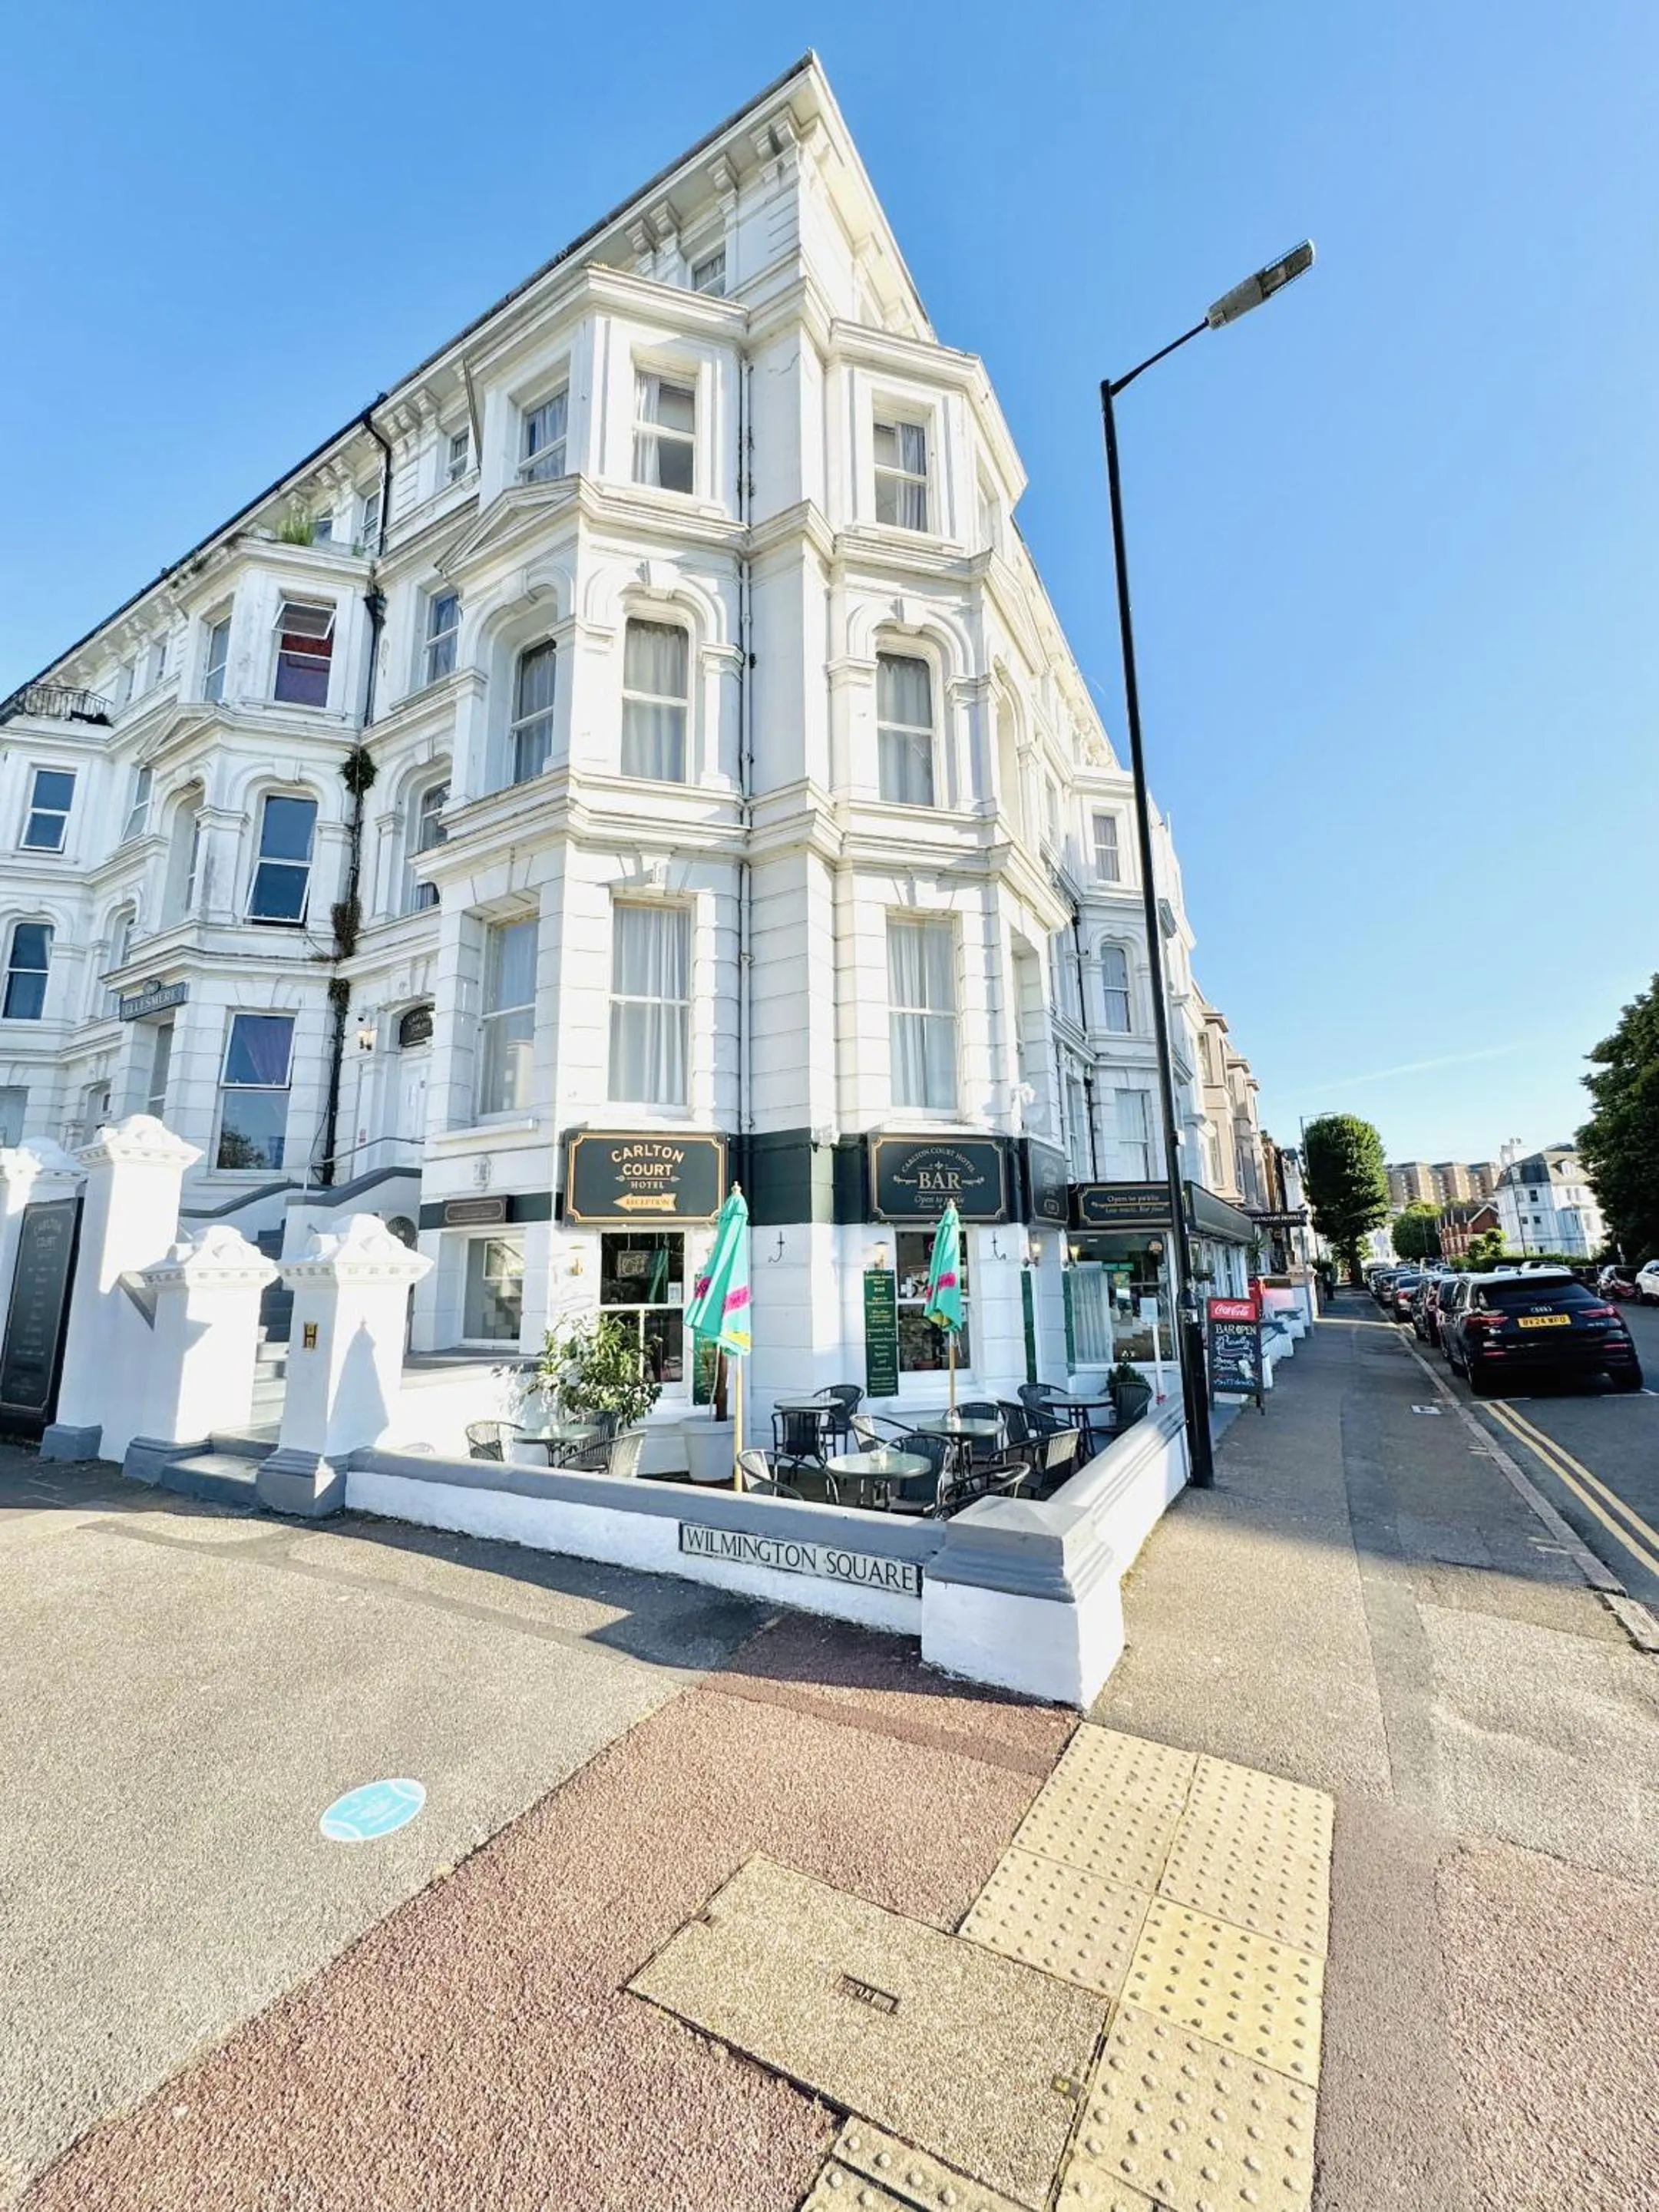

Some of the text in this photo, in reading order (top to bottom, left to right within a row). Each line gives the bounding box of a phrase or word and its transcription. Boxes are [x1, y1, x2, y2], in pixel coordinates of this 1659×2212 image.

[611, 1144, 685, 1163] CARLTON
[902, 1146, 976, 1173] CARLTON COURT HOTEL
[622, 1163, 673, 1176] COURT
[630, 1181, 664, 1189] HOTEL
[917, 1172, 963, 1189] BAR
[914, 1194, 934, 1206] Open
[1215, 1324, 1257, 1335] BAR OPEN
[686, 1528, 914, 1590] WILMINGTON SQUARE
